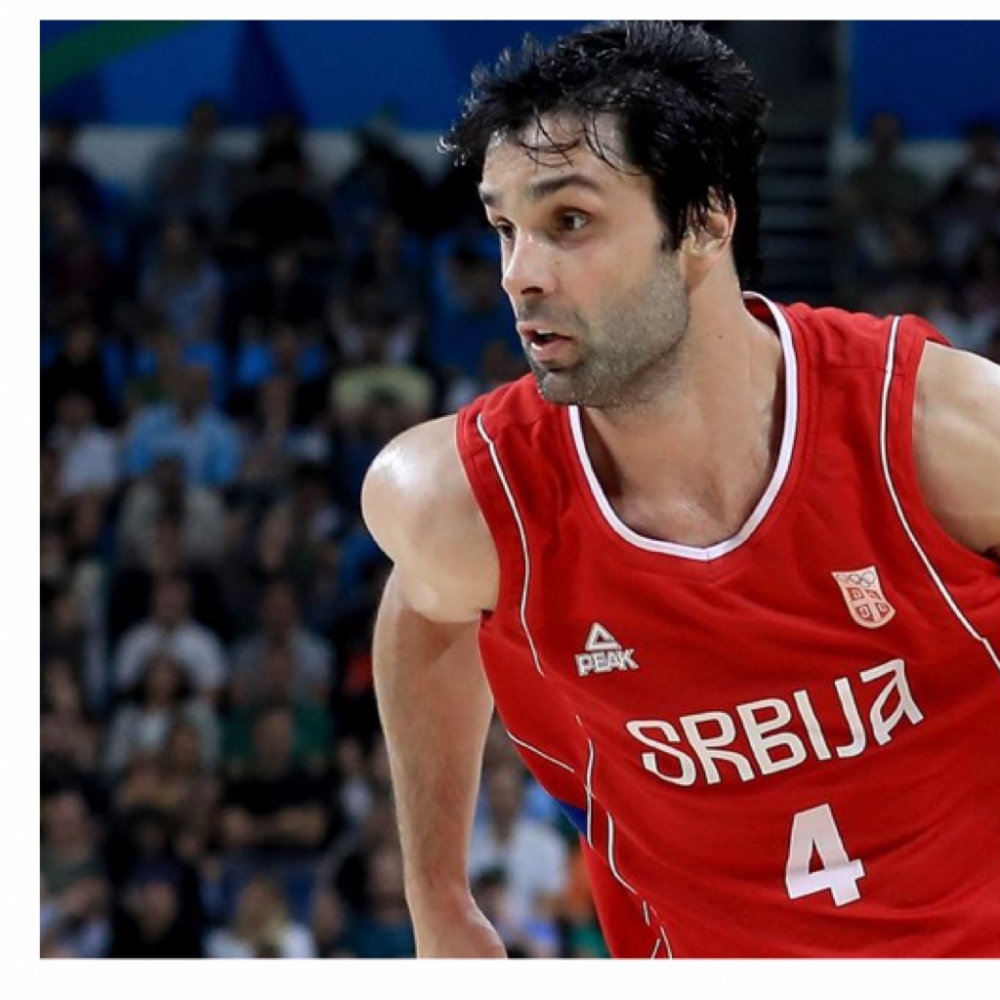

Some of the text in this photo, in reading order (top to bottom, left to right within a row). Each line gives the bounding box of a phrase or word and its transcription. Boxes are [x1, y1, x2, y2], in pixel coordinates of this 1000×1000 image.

[574, 649, 639, 677] PEAK
[626, 658, 924, 788] SRBIJA
[785, 803, 865, 907] 4
